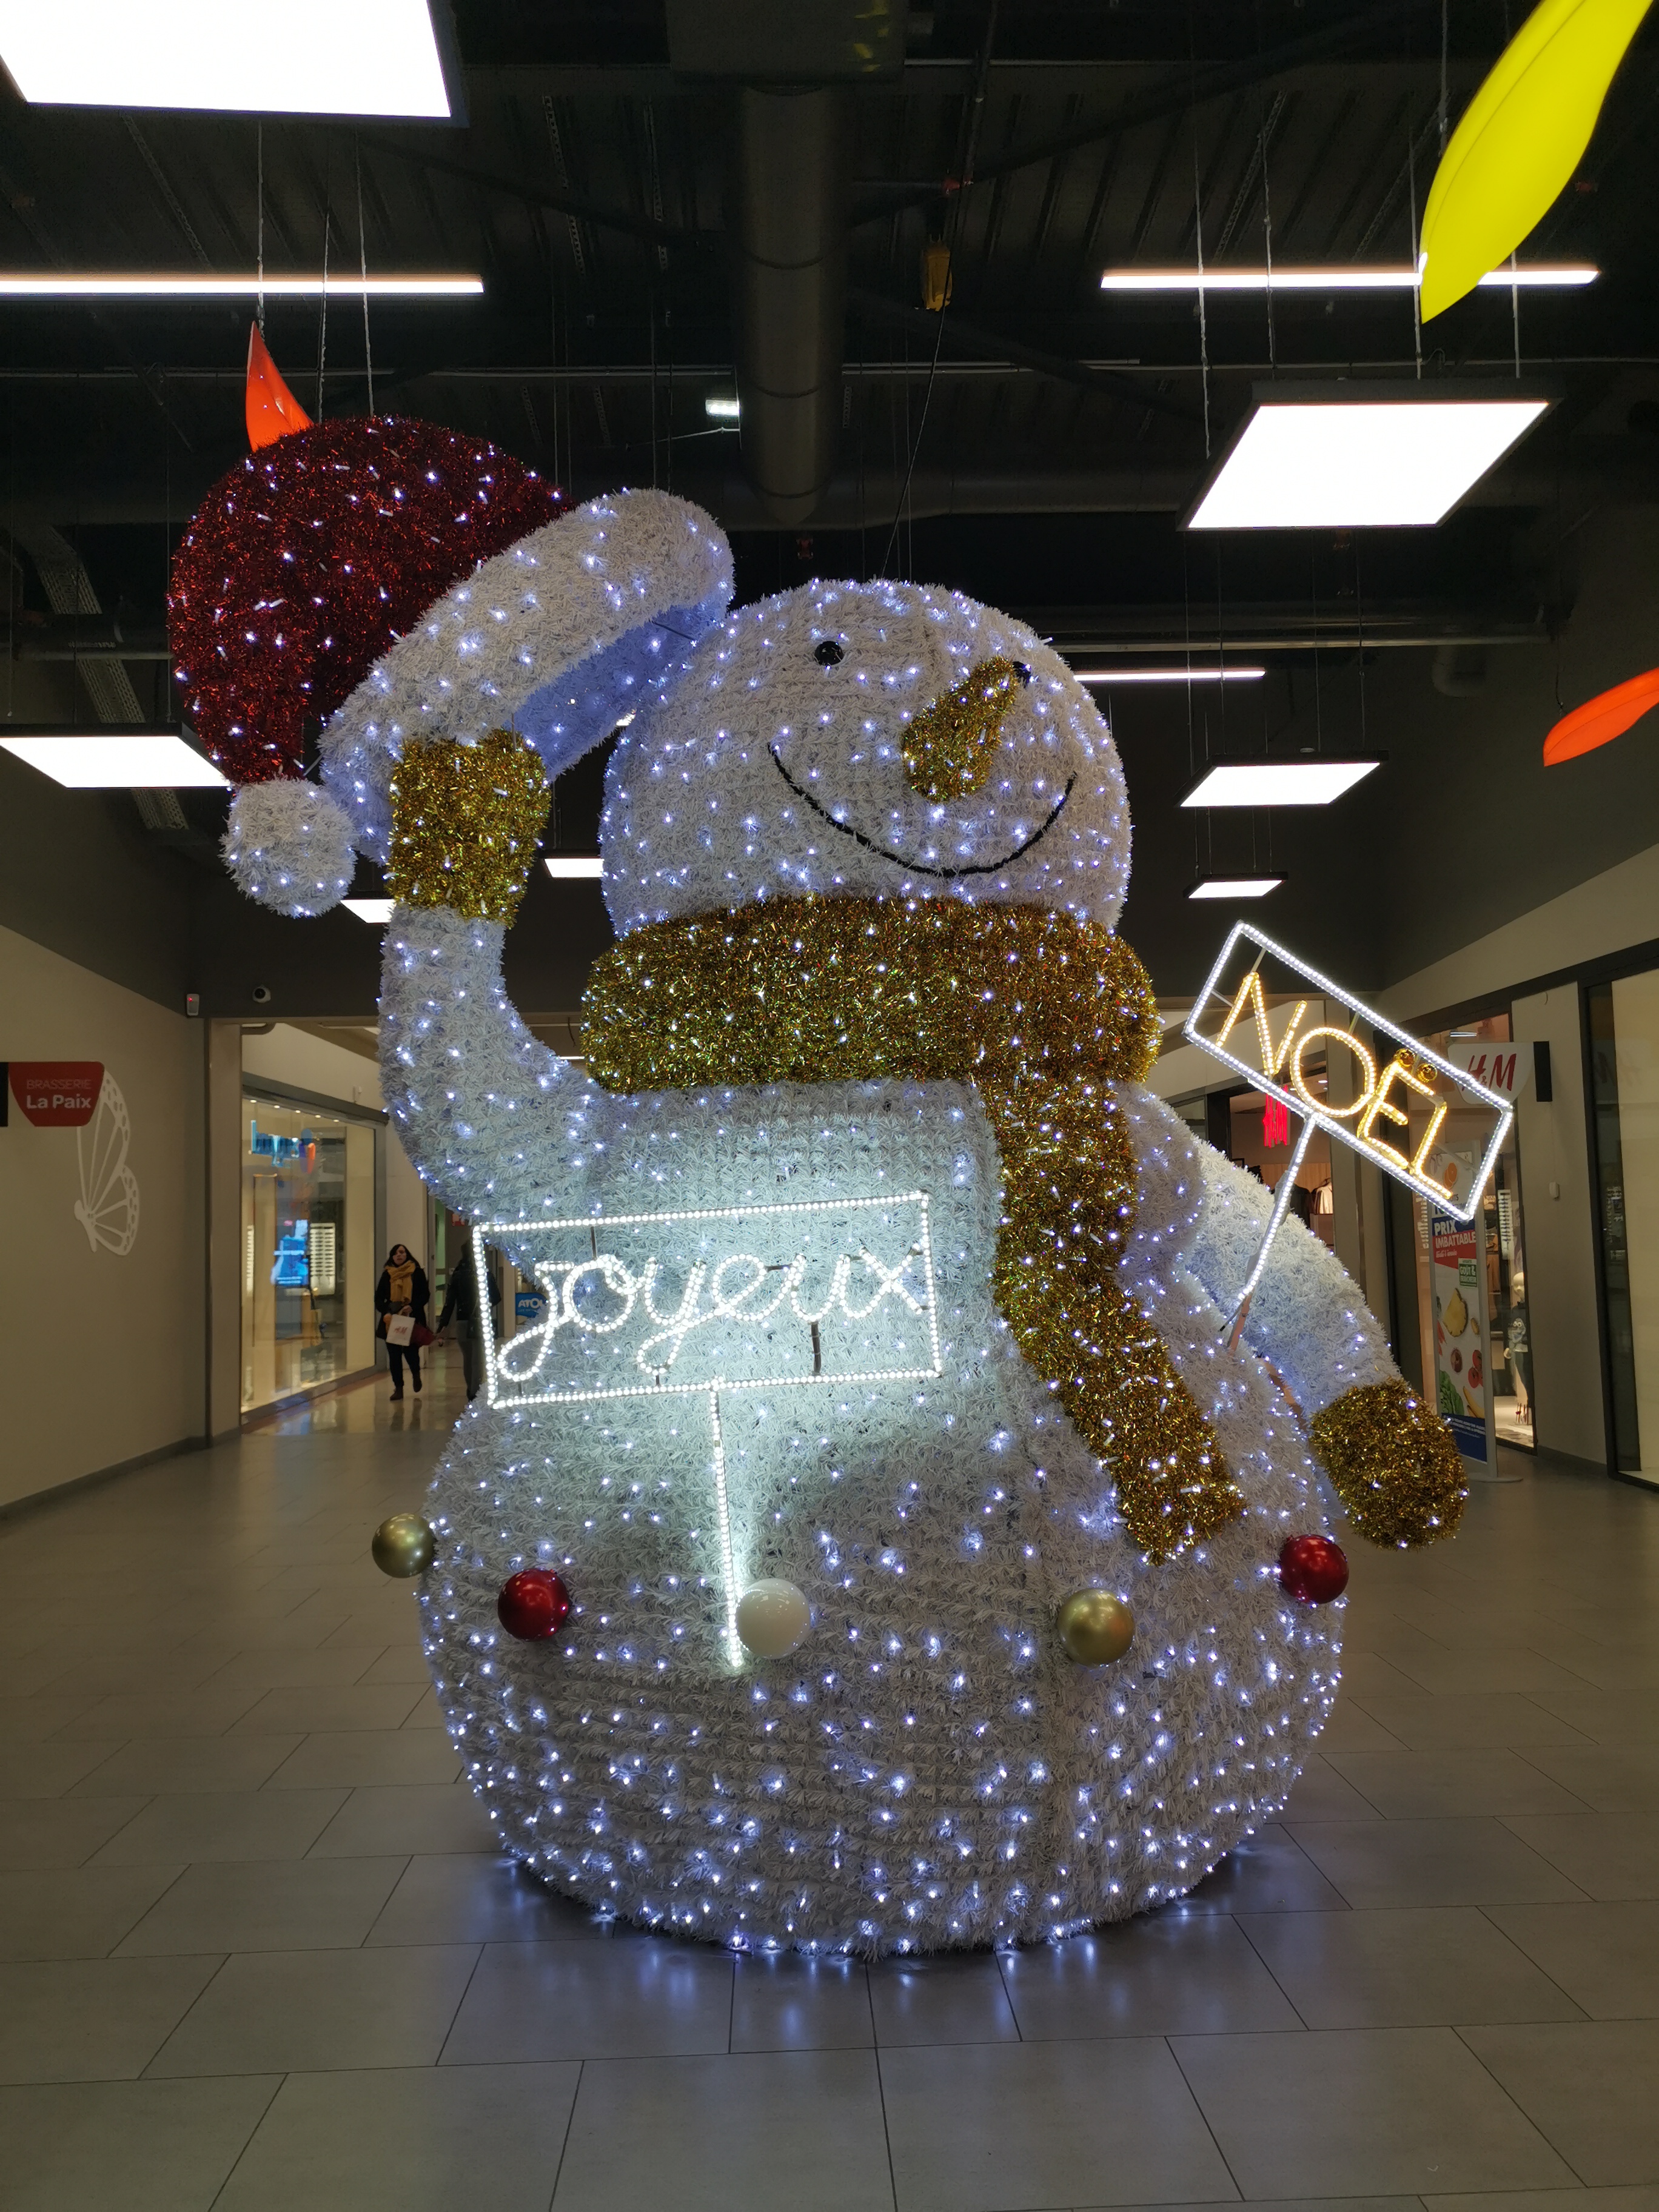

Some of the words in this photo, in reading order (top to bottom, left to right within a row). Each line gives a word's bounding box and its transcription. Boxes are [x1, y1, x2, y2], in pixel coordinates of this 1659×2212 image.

[26, 1079, 92, 1090] BRASSERIE
[26, 1094, 49, 1109] La
[52, 1093, 92, 1109] Paix
[1434, 1219, 1457, 1236] PRIX
[1435, 1231, 1476, 1248] IMBATTABLE
